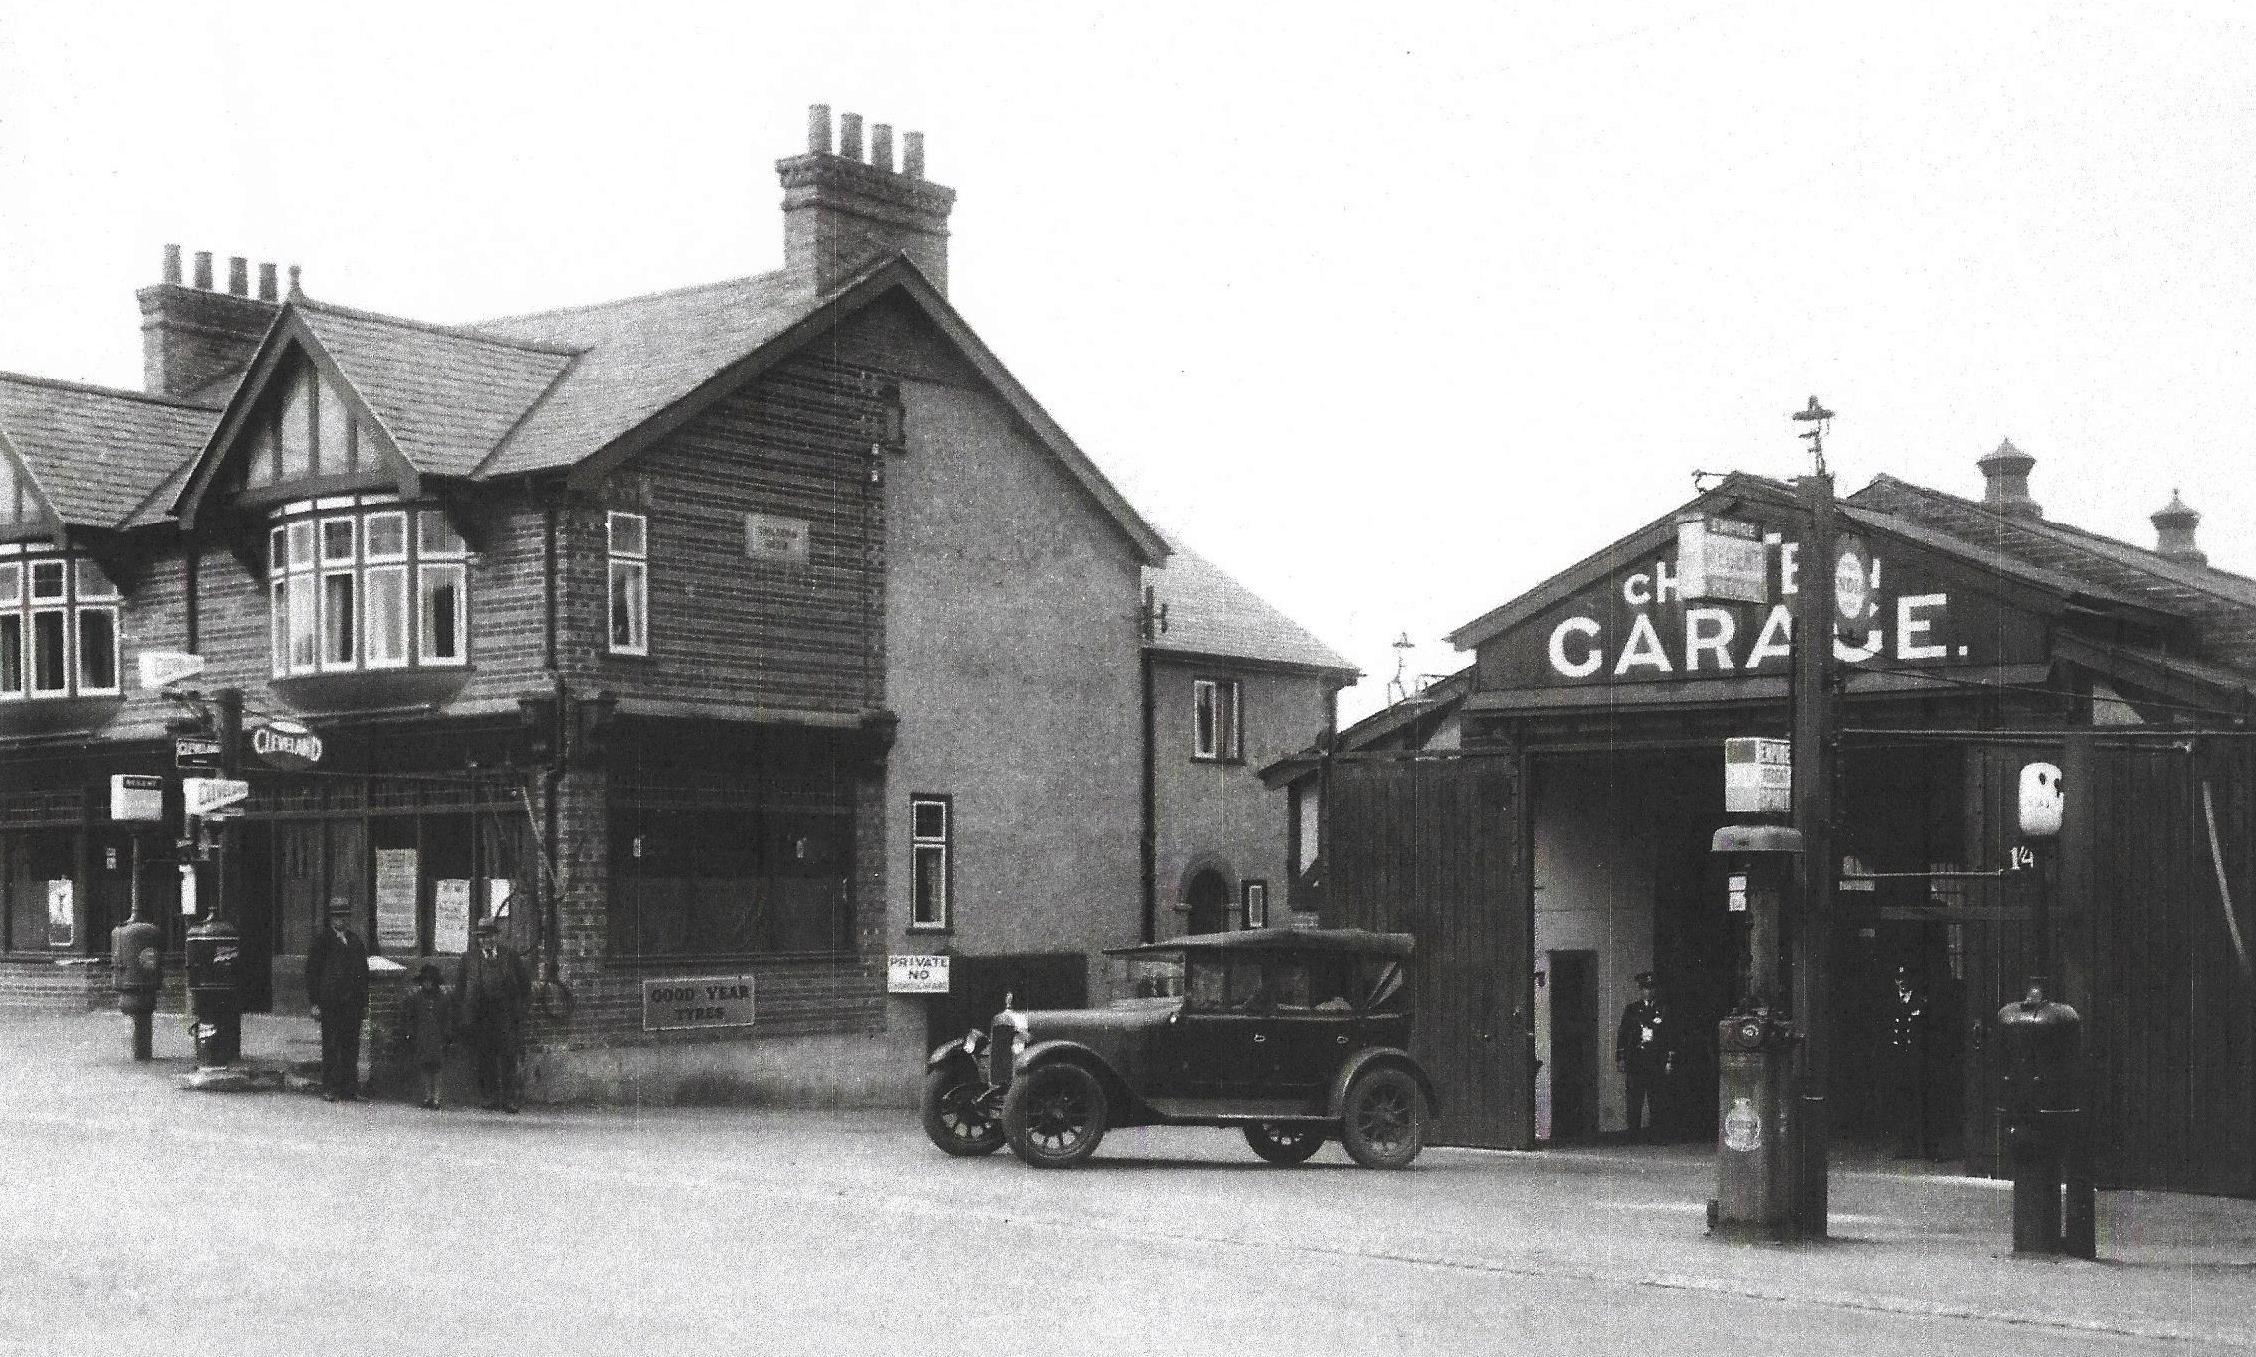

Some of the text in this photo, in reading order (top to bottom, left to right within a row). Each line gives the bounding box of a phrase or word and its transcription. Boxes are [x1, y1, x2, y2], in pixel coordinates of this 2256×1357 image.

[254, 728, 323, 762] CLEVELAND
[890, 957, 947, 968] PRIVATE
[908, 969, 930, 980] NO
[651, 984, 749, 1003] GOOD YEAR
[674, 1006, 725, 1020] TYRES
